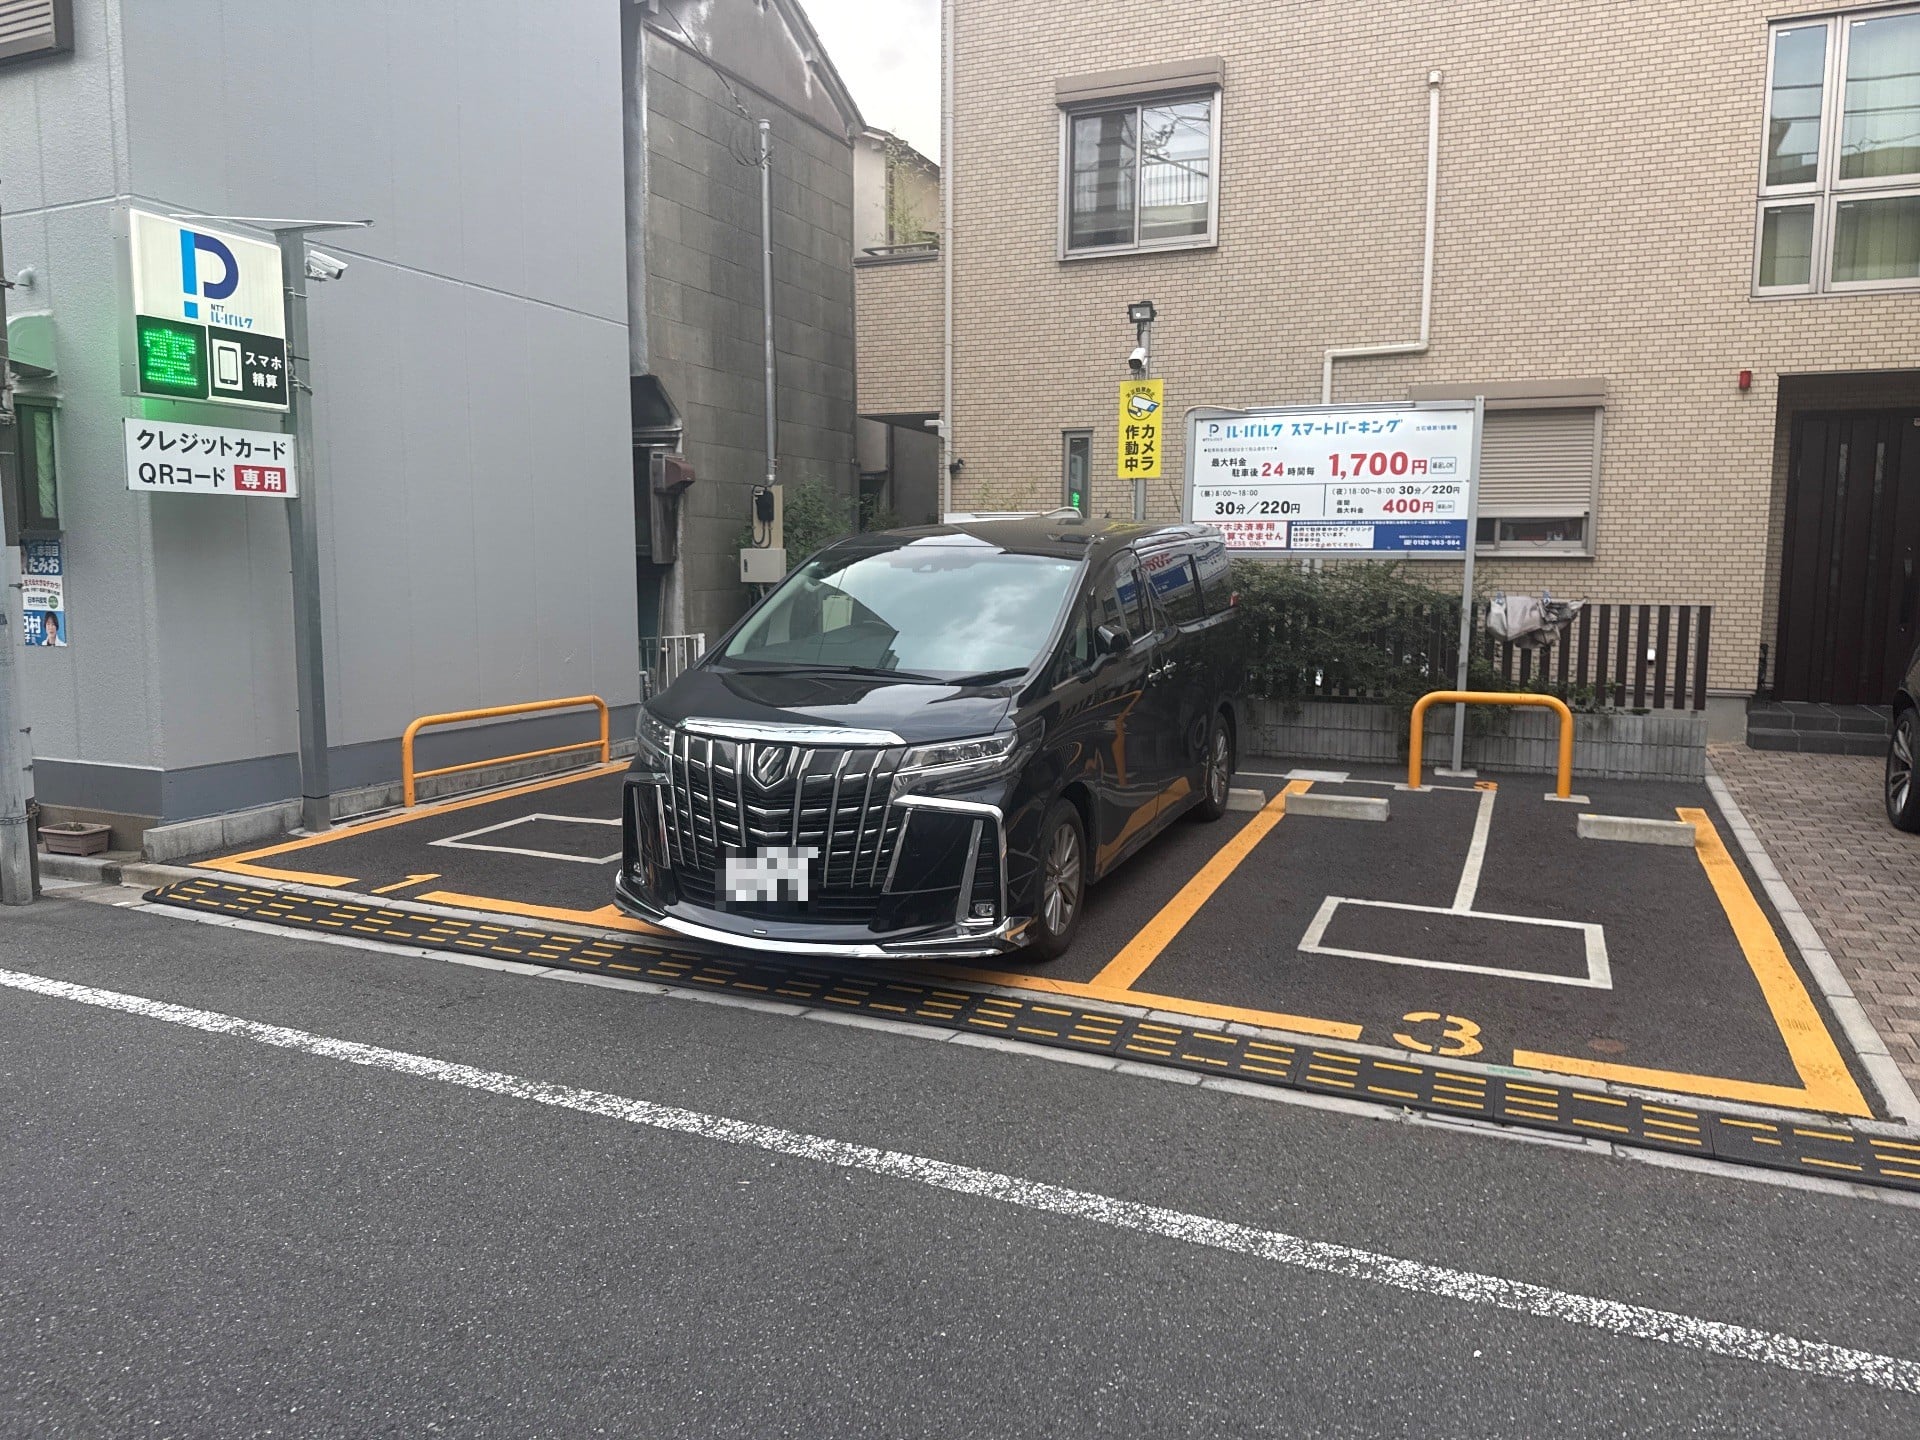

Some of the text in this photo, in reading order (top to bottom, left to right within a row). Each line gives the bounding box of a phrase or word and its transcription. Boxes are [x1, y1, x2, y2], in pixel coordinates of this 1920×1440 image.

[210, 303, 225, 313] NTT
[143, 329, 198, 386] 空
[245, 351, 282, 371] スマホ
[252, 371, 278, 389] 精算
[136, 429, 286, 461] クレジットカード
[1125, 425, 1140, 471] 作動中
[1141, 424, 1155, 471] カメラ
[1211, 458, 1247, 467] 最大料金
[1329, 451, 1428, 480] 1,700円
[138, 462, 282, 491] QRコード 専用
[1215, 501, 1301, 514] 30分／220円
[1382, 498, 1434, 513] 400円
[1224, 532, 1283, 540] 算できません
[29, 557, 59, 573] たみお
[1392, 1011, 1484, 1057] 3
